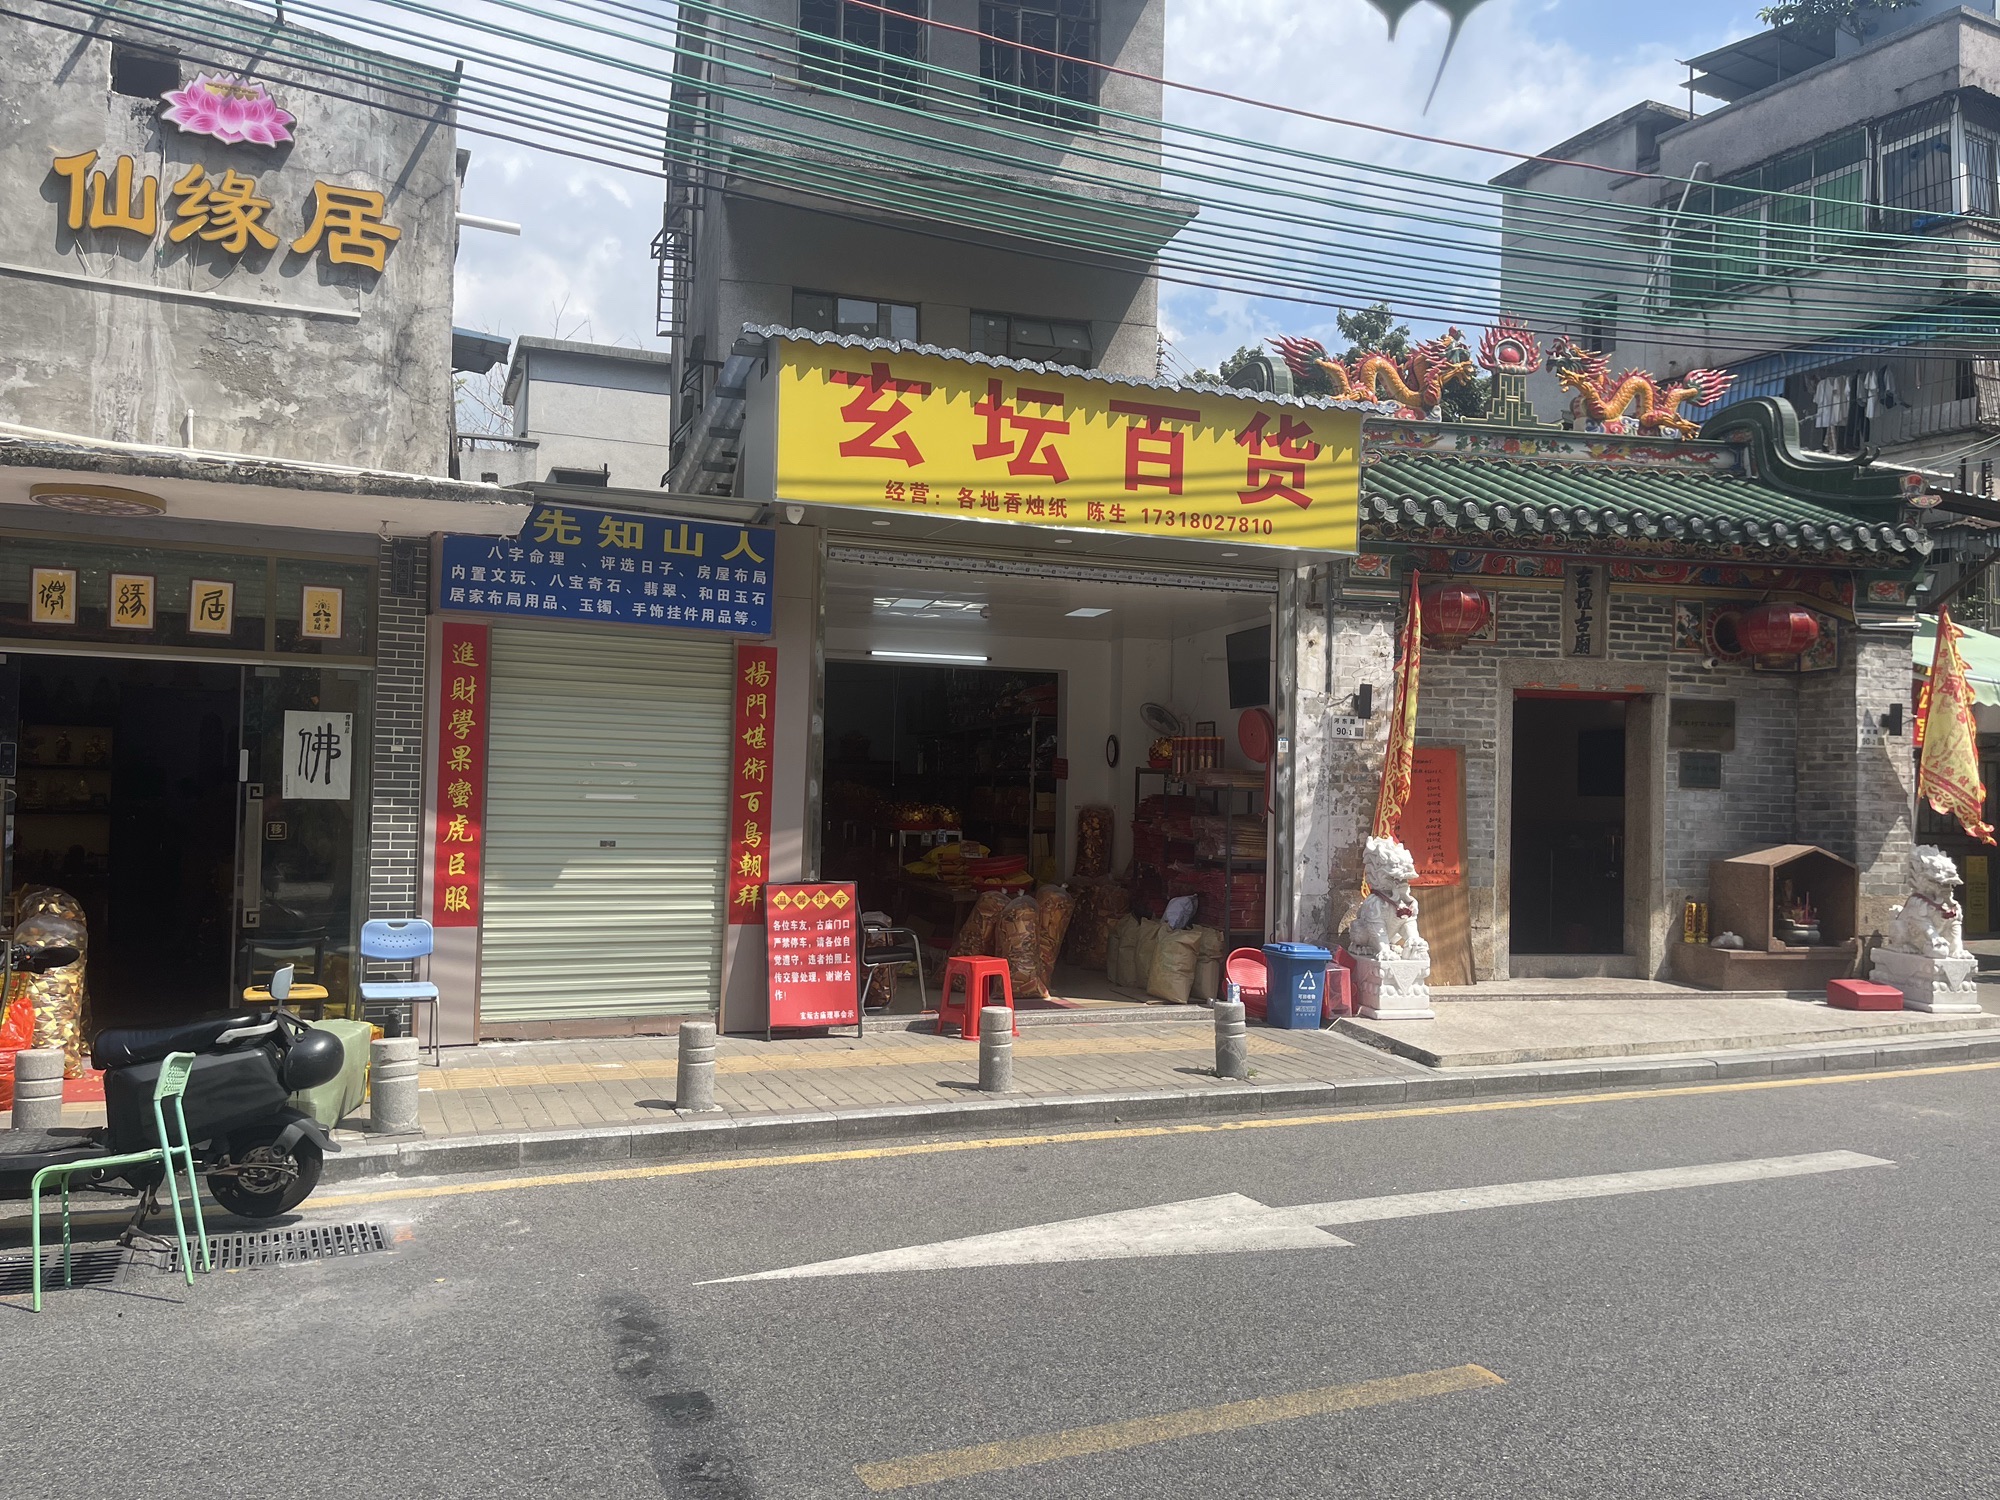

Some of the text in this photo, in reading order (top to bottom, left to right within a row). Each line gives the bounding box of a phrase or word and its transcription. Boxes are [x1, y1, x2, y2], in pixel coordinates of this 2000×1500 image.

[53, 149, 401, 272] 仙缘居
[830, 362, 1321, 510] 玄坛百货
[534, 509, 766, 564] 先知山人
[1086, 500, 1128, 525] 陈生
[1141, 507, 1273, 536] 17318027810
[298, 722, 342, 785] 佛
[776, 894, 847, 906] 温馨提示
[773, 919, 850, 931] 各位车友，古庙门口
[773, 936, 851, 949] 严禁停车，请各位自
